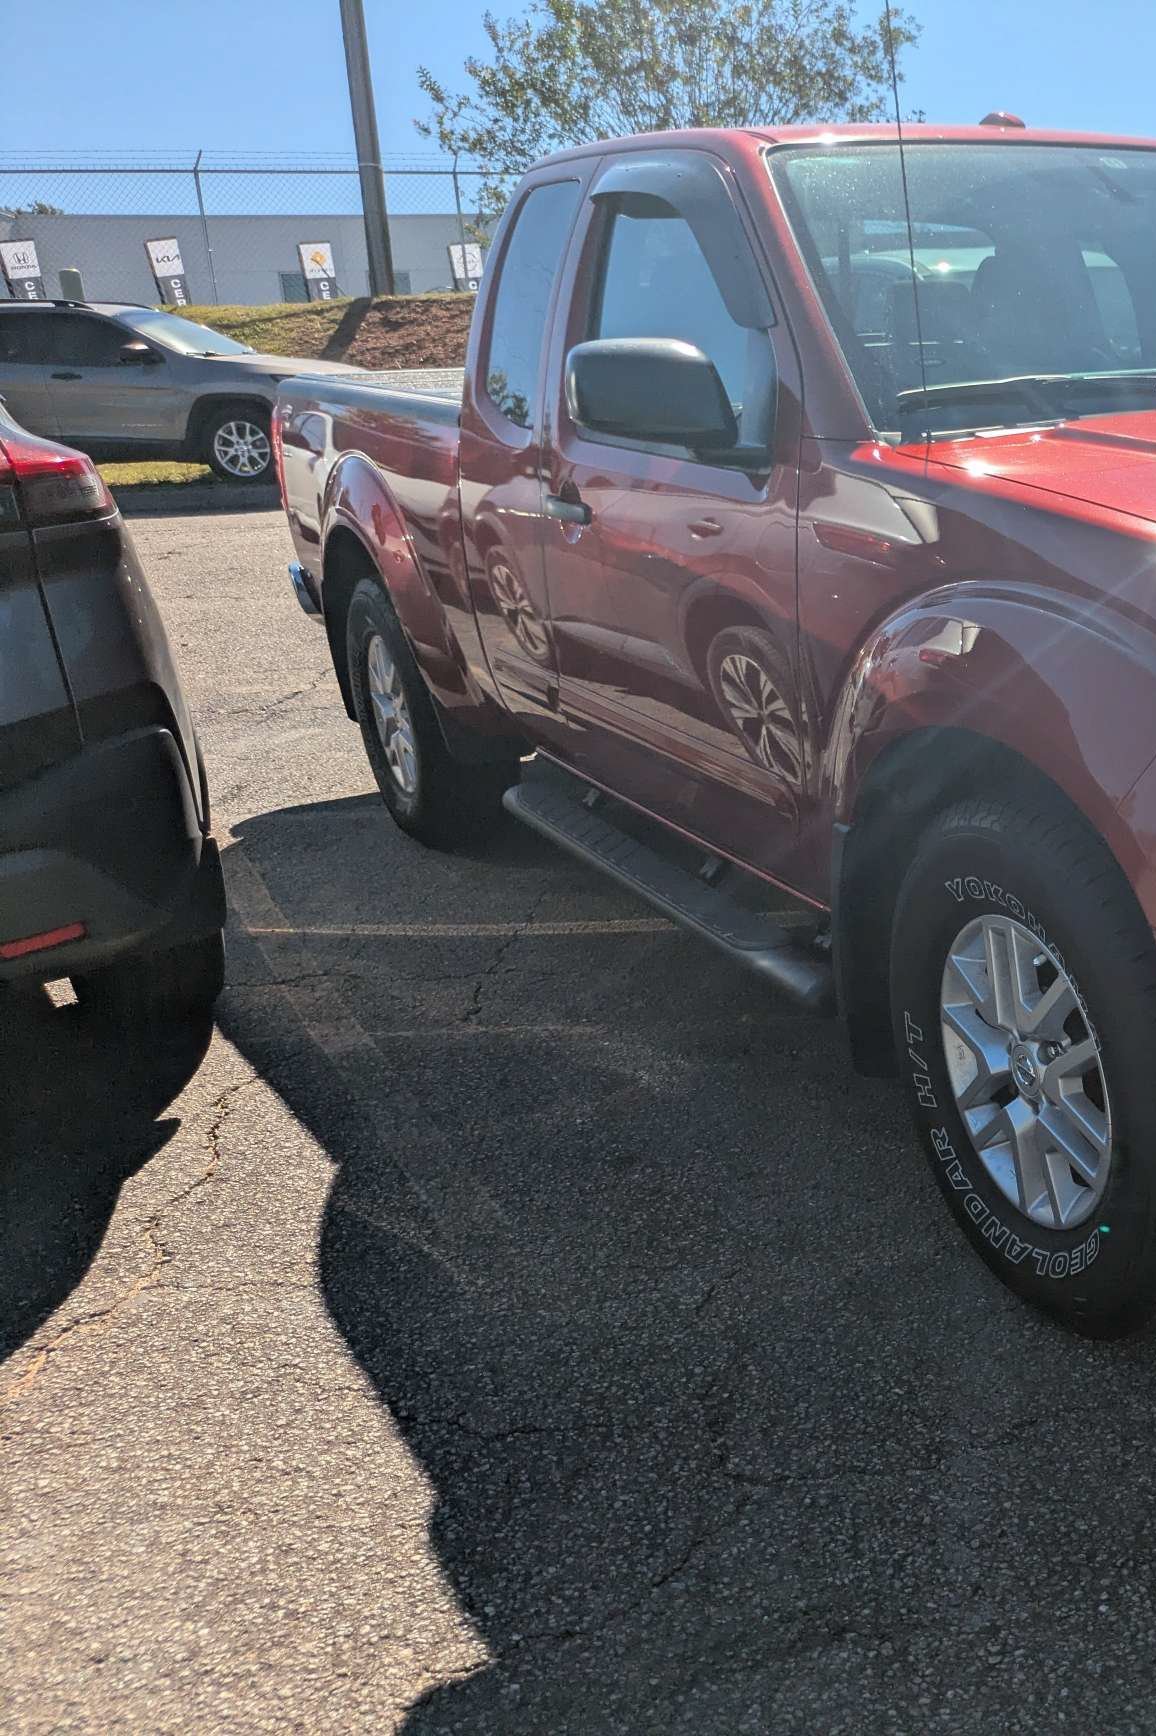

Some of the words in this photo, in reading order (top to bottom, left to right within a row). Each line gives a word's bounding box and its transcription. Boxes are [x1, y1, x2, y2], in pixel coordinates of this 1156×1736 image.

[155, 254, 180, 263] KIA
[904, 1010, 938, 1108] H/T
[930, 1126, 1100, 1279] GEOLANDAR
